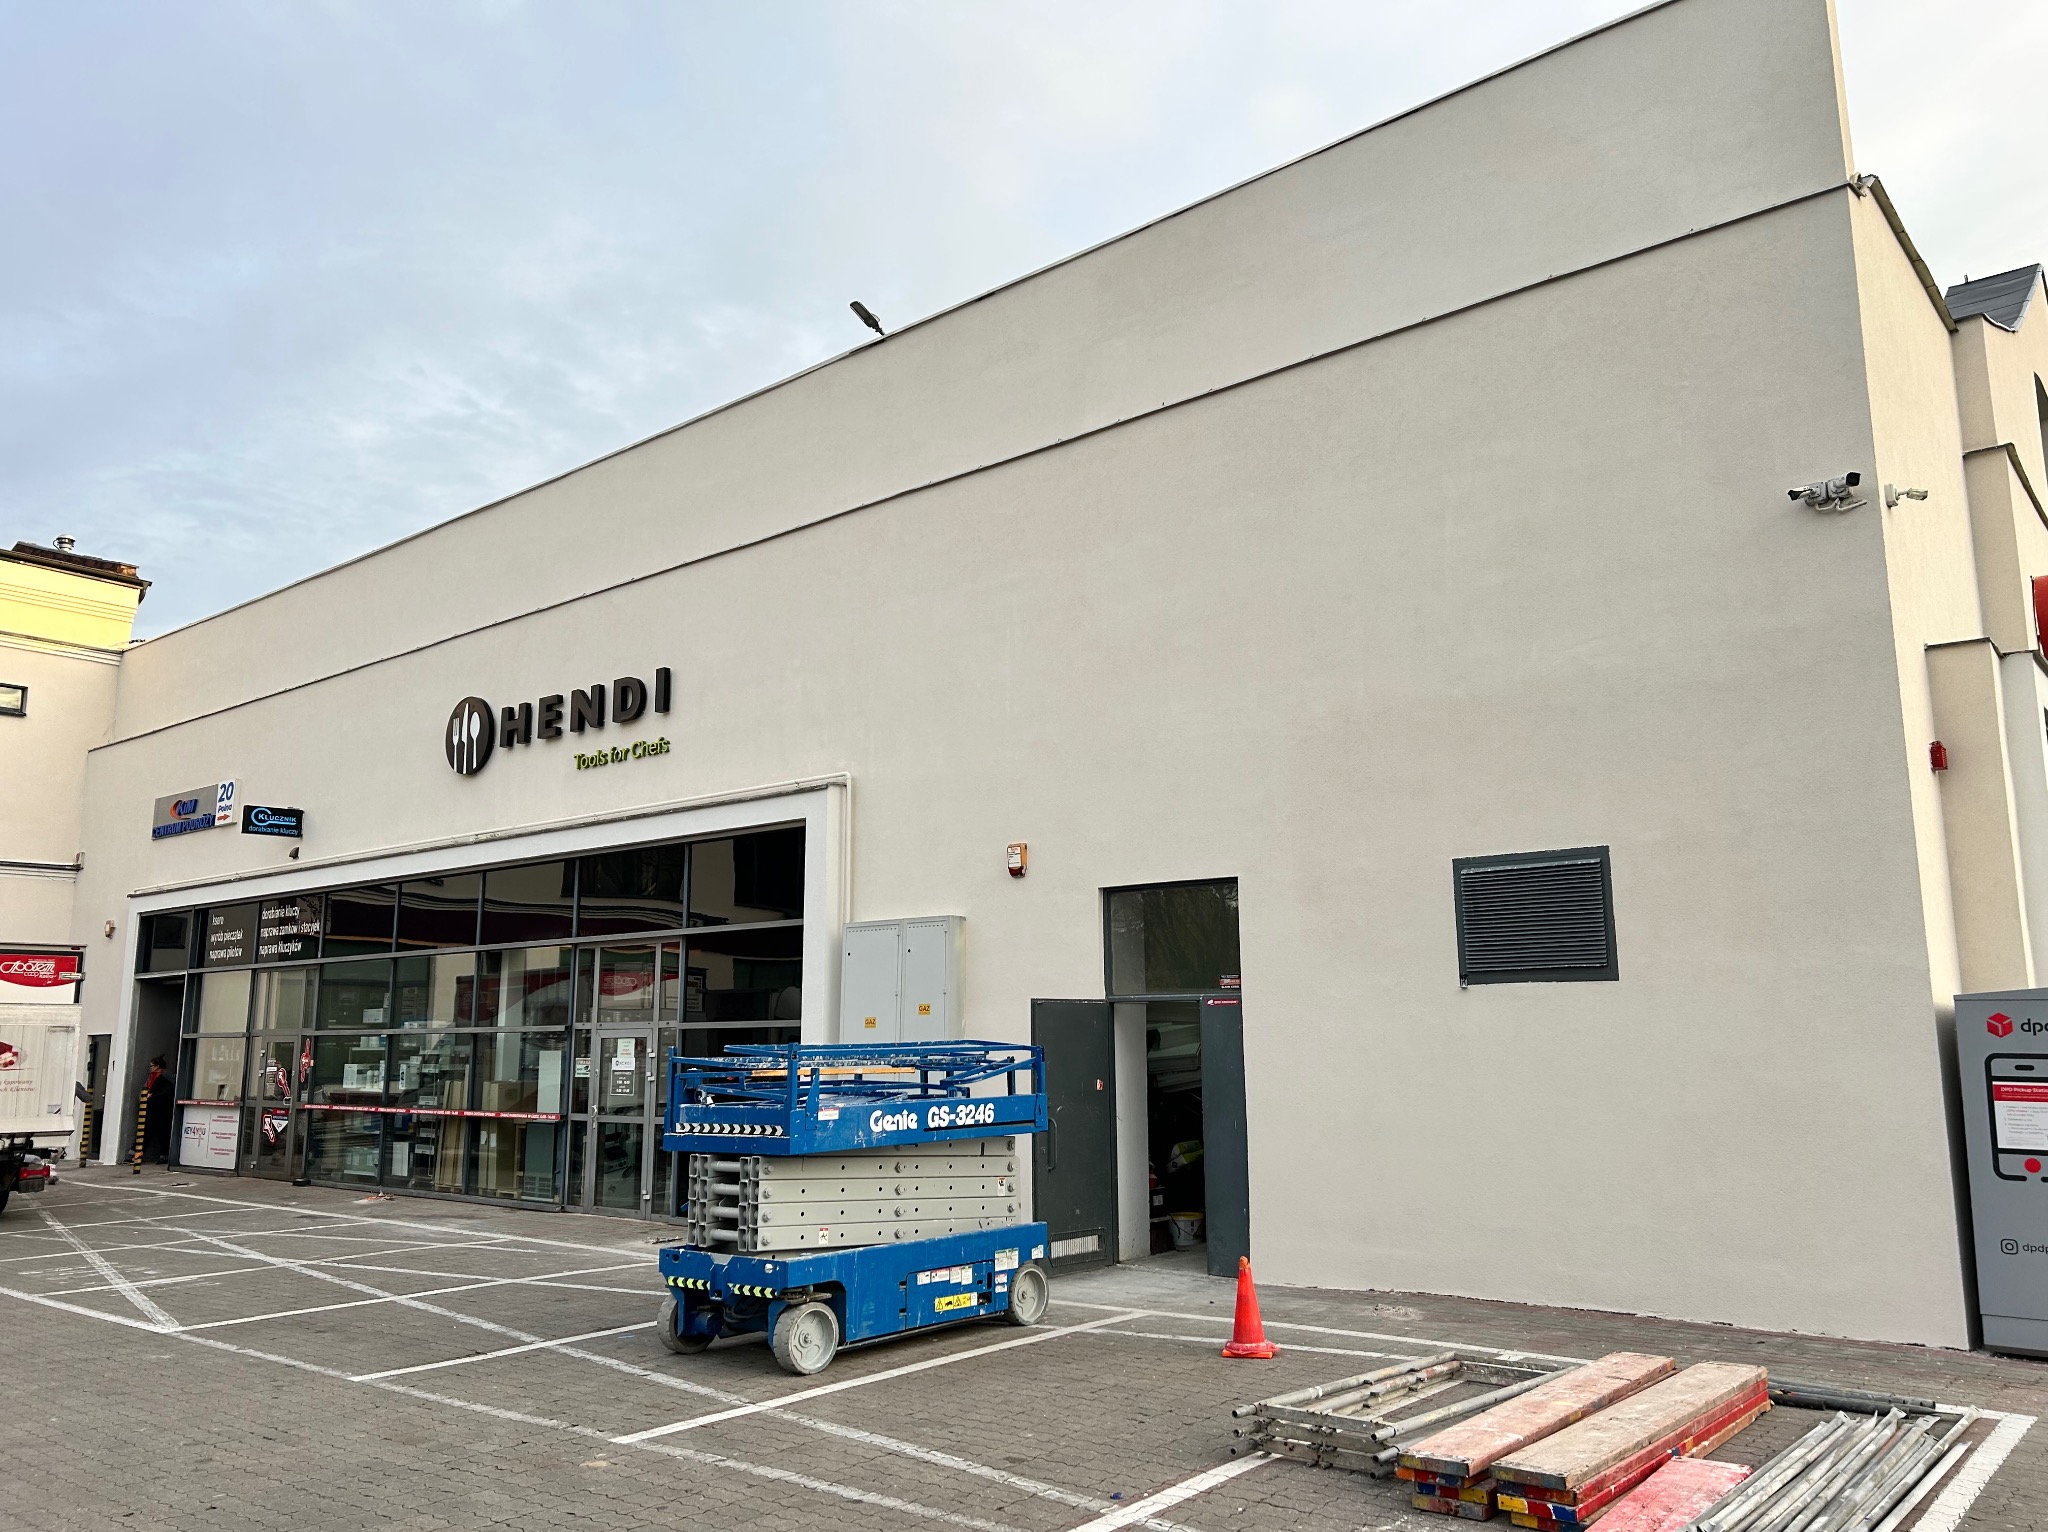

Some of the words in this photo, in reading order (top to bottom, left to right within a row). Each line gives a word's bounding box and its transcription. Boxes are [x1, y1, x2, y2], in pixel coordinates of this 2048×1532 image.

[500, 667, 671, 748] HENDI
[574, 750, 608, 770] Tools
[610, 746, 629, 763] for
[631, 736, 670, 759] Chefs
[218, 781, 234, 802] 20
[258, 813, 297, 823] KLUCZNIK
[248, 825, 279, 834] dorabianie
[280, 828, 298, 836] kluczy
[212, 914, 225, 925] ksero
[262, 906, 285, 919] dorabianie
[286, 905, 300, 917] kluczy
[224, 928, 243, 943] pieczątek
[260, 926, 279, 939] naprawa
[279, 922, 298, 935] zamków
[301, 918, 320, 935] stacyjek
[209, 949, 226, 961] naprawa
[226, 945, 243, 960] pilotów
[259, 943, 278, 957] naprawa
[278, 939, 302, 955] kluczyków
[864, 1018, 876, 1026] GAZ
[869, 1109, 918, 1132] Genie
[927, 1102, 995, 1128] GS-3246
